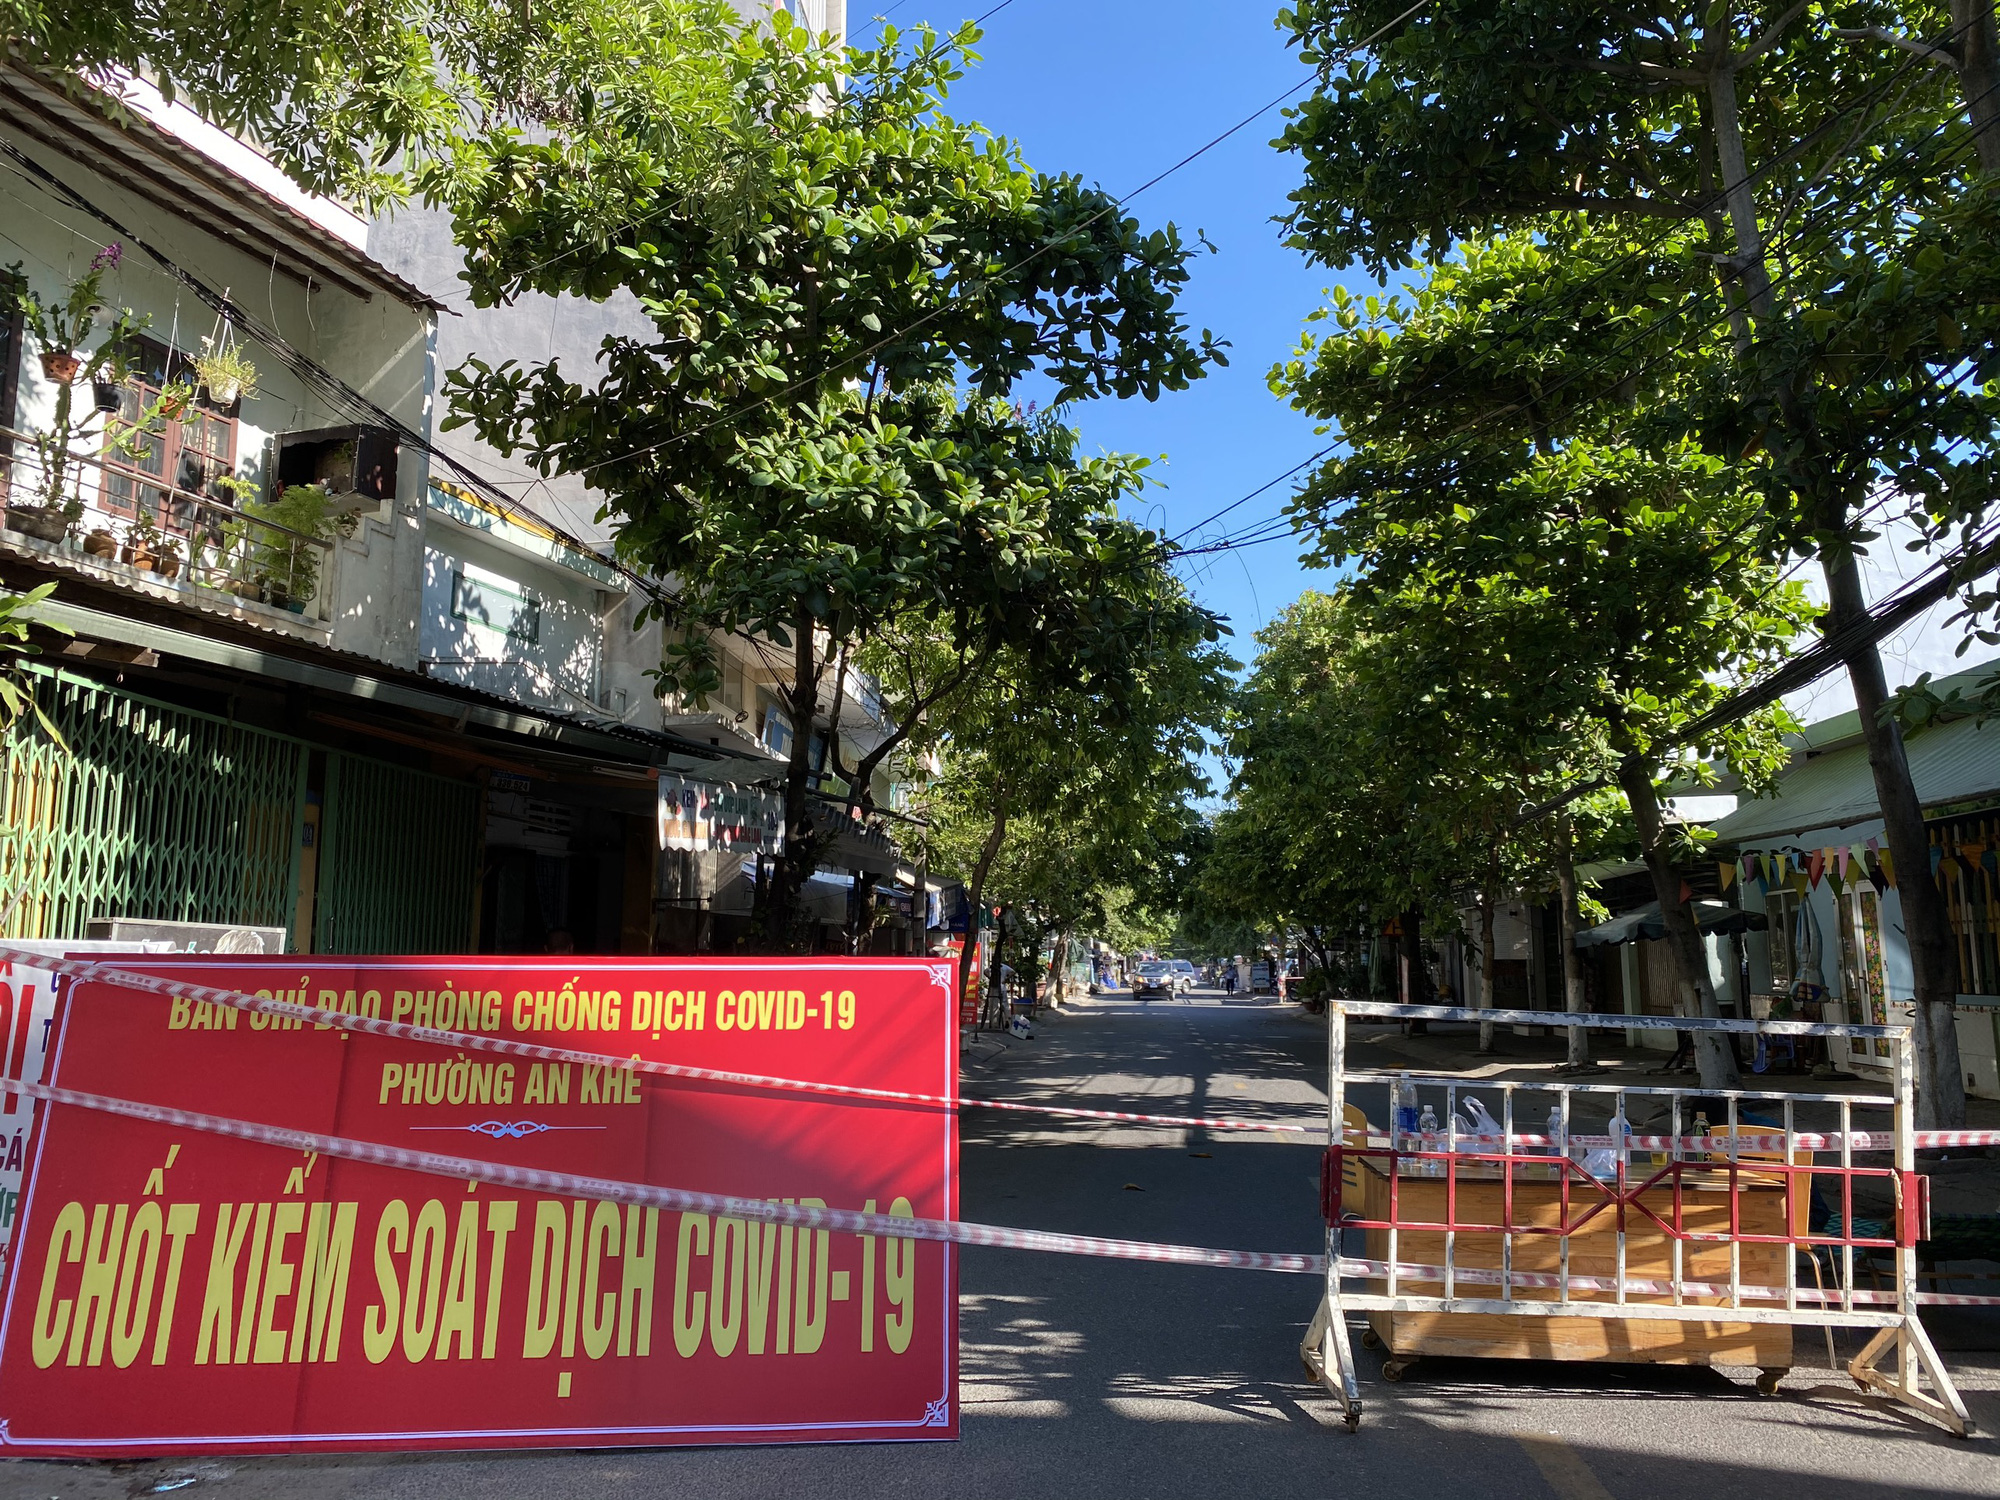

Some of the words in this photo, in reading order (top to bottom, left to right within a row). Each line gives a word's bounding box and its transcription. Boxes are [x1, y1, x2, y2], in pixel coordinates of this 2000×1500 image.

[168, 989, 242, 1030] BAN
[250, 975, 310, 1031] CHỈ
[314, 989, 382, 1040] ĐẠO
[391, 980, 503, 1031] PHÒNG
[511, 976, 622, 1031] CHỐNG
[631, 990, 706, 1040] DỊCH
[715, 990, 856, 1031] COVID-19
[379, 1053, 516, 1105] PHƯỜNG
[523, 1063, 571, 1104] AN
[580, 1053, 642, 1105] KHÊ
[32, 1144, 200, 1369] CHỐT
[194, 1150, 359, 1365] KIỂM
[363, 1178, 519, 1364] SOÁT
[523, 1200, 660, 1398] DỊCH
[673, 1196, 915, 1359] COVID-19
